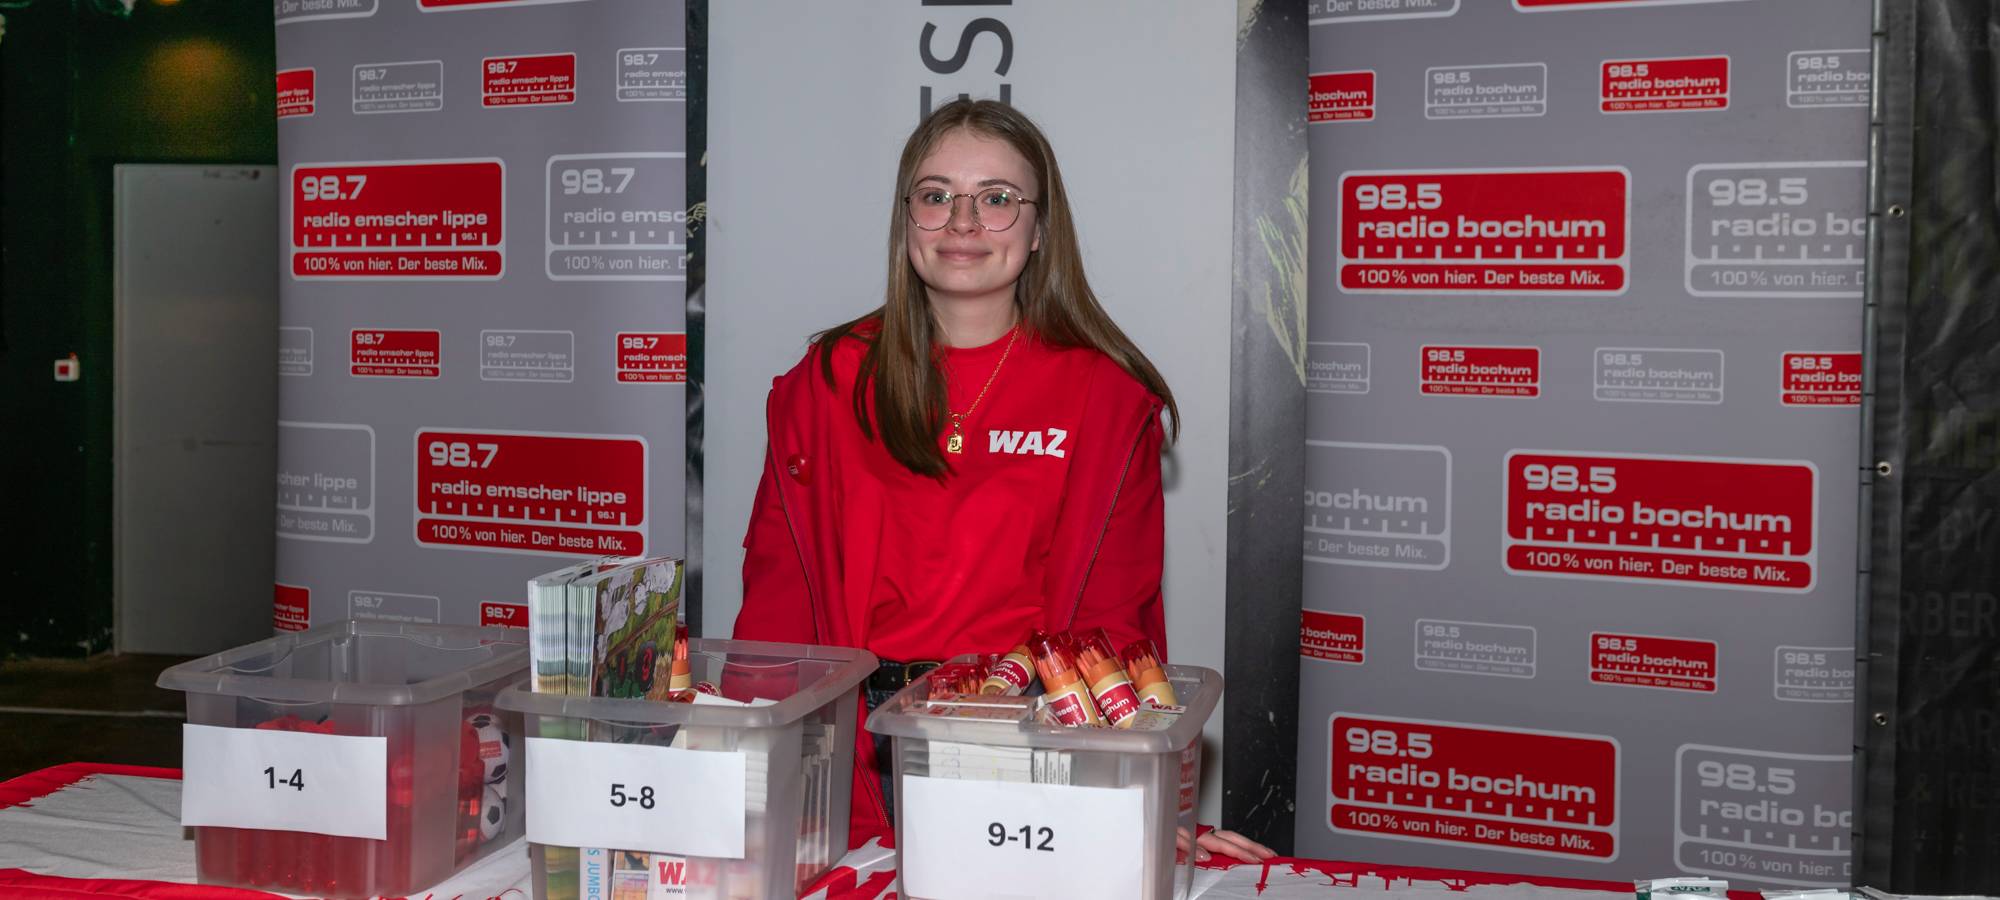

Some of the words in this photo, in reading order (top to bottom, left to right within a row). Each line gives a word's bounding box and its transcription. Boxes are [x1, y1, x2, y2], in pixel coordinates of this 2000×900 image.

[1326, 0, 1352, 13] Der
[1357, 0, 1400, 10] beste
[488, 61, 516, 74] 98.7
[624, 54, 659, 66] 98.7
[1797, 56, 1840, 70] 98.5
[1433, 71, 1470, 84] 98.5
[1608, 64, 1648, 78] 98.5
[1798, 71, 1843, 81] radio
[1434, 85, 1473, 96] radio
[1476, 82, 1537, 94] bochum
[1610, 78, 1651, 90] radio
[1655, 75, 1719, 88] bochum
[1314, 90, 1367, 101] bochum
[302, 175, 367, 200] 98.7
[562, 168, 635, 194] 98.7
[1356, 183, 1444, 210] 98.5
[1708, 178, 1808, 206] 98.5
[304, 212, 349, 227] radio
[355, 211, 438, 226] emscher
[443, 211, 488, 228] lippe
[564, 208, 616, 223] radio
[1359, 215, 1451, 239] radio
[1459, 213, 1606, 238] bochum
[1712, 213, 1817, 236] radio
[304, 257, 340, 270] 100%
[344, 260, 364, 270] von
[369, 257, 392, 270] hier.
[399, 257, 420, 270] Der
[425, 257, 458, 270] beste
[462, 257, 487, 270] Mix.
[564, 256, 604, 270] 100%
[609, 259, 633, 270] von
[638, 256, 671, 270] hier.
[1358, 270, 1407, 285] 100%
[1412, 273, 1439, 284] von
[1444, 270, 1477, 284] hier.
[1484, 270, 1514, 284] Der
[1520, 270, 1564, 284] beste
[1570, 270, 1605, 285] Mix.
[1712, 271, 1767, 286] 100%
[1774, 273, 1804, 286] von
[1811, 271, 1848, 286] hier.
[356, 333, 383, 344] 98.7
[623, 337, 659, 349] 98.7
[624, 353, 650, 361] radio
[1427, 350, 1465, 362] 98.5
[1602, 353, 1641, 365] 98.5
[1790, 357, 1833, 370] 98.5
[1312, 361, 1361, 372] bochum
[1429, 363, 1468, 373] radio
[1471, 364, 1531, 375] bochum
[1603, 367, 1644, 378] radio
[1648, 368, 1713, 379] bochum
[1791, 372, 1836, 382] radio
[988, 428, 1067, 458] WAZ
[428, 441, 498, 469] 98.7
[314, 473, 357, 491] lippe
[1523, 464, 1617, 493] 98.5
[431, 478, 481, 496] radio
[486, 481, 573, 501] emscher
[577, 486, 626, 506] lippe
[597, 509, 614, 518] 96.1
[1526, 500, 1624, 524] radio
[1633, 502, 1791, 533] bochum
[297, 518, 328, 531] beste
[332, 519, 357, 534] Mix.
[431, 524, 471, 539] 100%
[474, 529, 496, 541] von
[500, 528, 526, 543] hier.
[531, 530, 554, 544] Der
[558, 531, 593, 547] beste
[598, 533, 626, 549] Mix.
[1319, 539, 1343, 553] Der
[1348, 541, 1389, 557] beste
[1395, 544, 1427, 559] Mix.
[1526, 551, 1579, 568] 100%
[1584, 557, 1613, 570] von
[1619, 556, 1654, 573] hier.
[1661, 559, 1693, 575] Der
[1699, 561, 1747, 578] beste
[1753, 564, 1790, 581] Mix.
[485, 606, 515, 619] 98.7
[1306, 627, 1357, 643] bochum
[1423, 624, 1460, 638] 98.5
[1424, 637, 1463, 650] radio
[1466, 640, 1526, 655] bochum
[1597, 637, 1636, 651] 98.5
[1599, 651, 1639, 664] radio
[1643, 654, 1707, 669] bochum
[1785, 653, 1826, 665] 98.5
[1785, 667, 1829, 678] radio
[1346, 727, 1433, 759] 98.5
[263, 766, 305, 792] 1-4
[1349, 763, 1440, 788] radio
[1448, 768, 1595, 804] bochum
[1697, 761, 1796, 795] 98.5
[609, 783, 655, 810] 5-8
[1700, 799, 1805, 826] radio
[987, 822, 1055, 853] 9-12
[1349, 810, 1399, 829] 100%
[1404, 819, 1431, 832] von
[1437, 819, 1469, 836] hier.
[1476, 824, 1505, 840] Der
[1511, 827, 1555, 846] beste
[1561, 832, 1595, 850] Mix.
[1700, 850, 1756, 870] 100%
[1762, 860, 1792, 873] von
[1799, 861, 1835, 876] hier.
